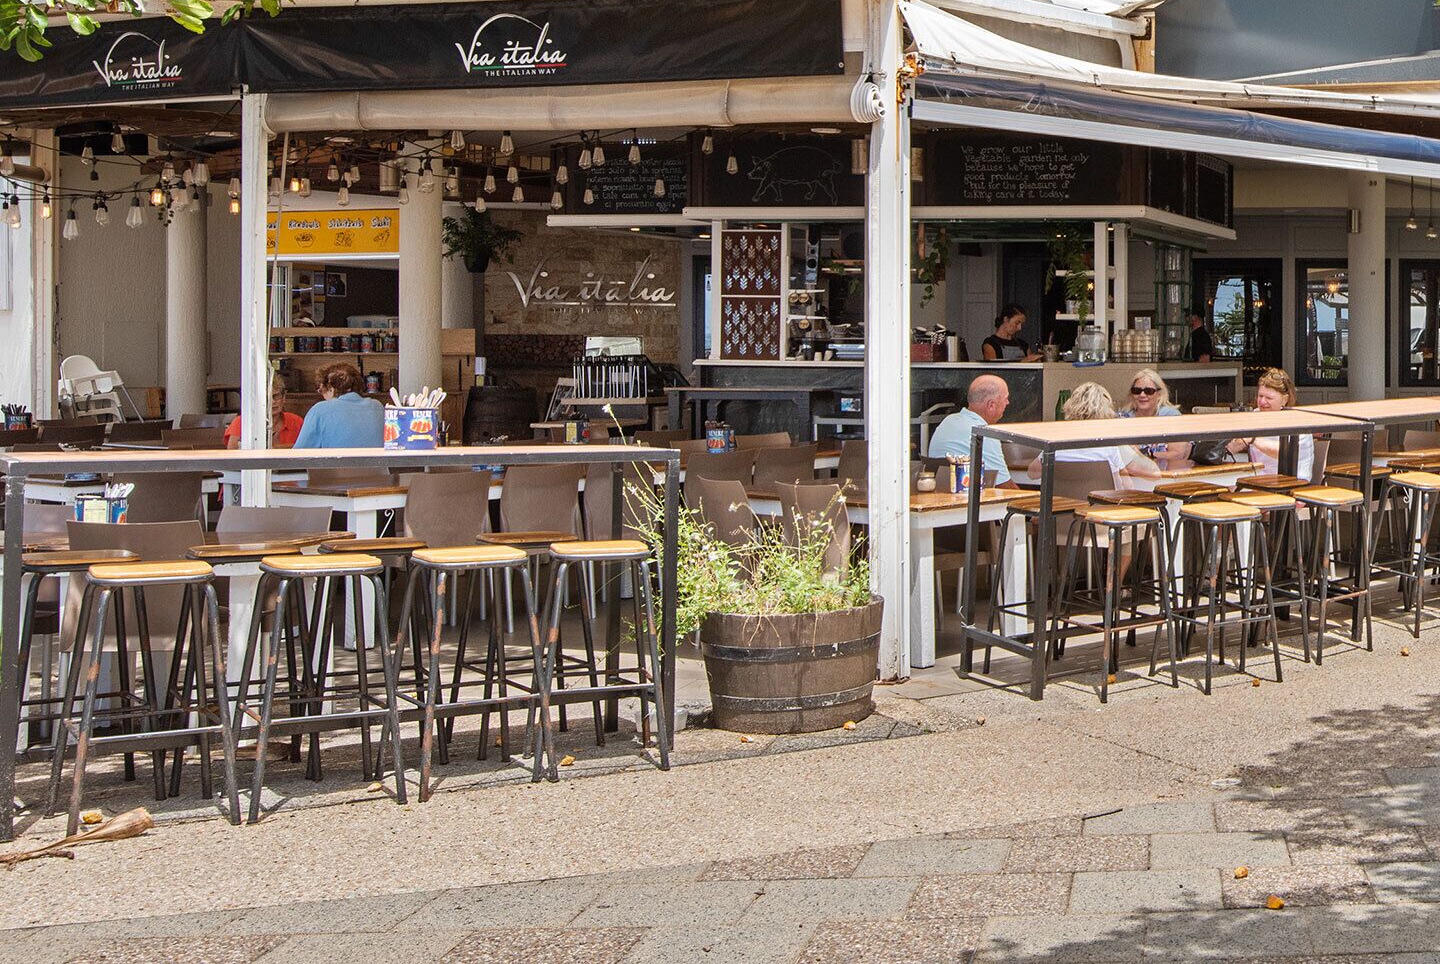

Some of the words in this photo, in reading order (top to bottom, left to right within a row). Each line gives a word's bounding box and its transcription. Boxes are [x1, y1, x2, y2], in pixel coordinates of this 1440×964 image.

[500, 22, 568, 65] italia
[1012, 145, 1032, 154] our
[507, 258, 570, 309] Via
[577, 252, 676, 302] italia
